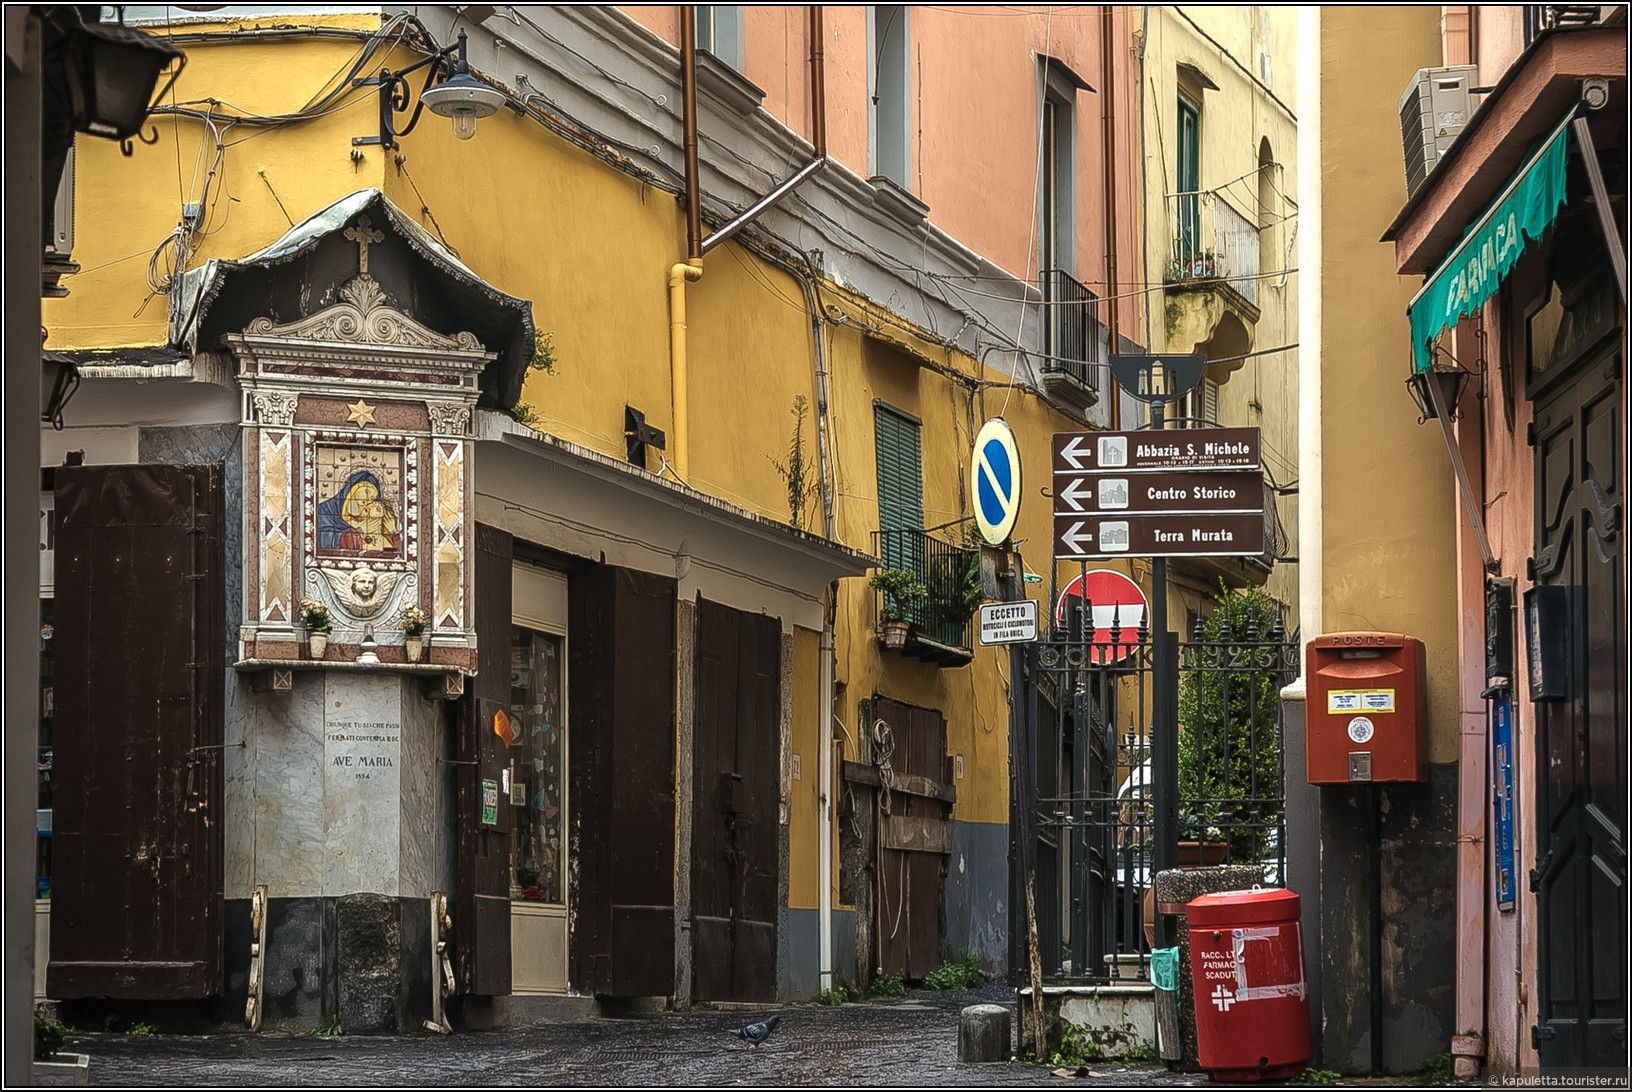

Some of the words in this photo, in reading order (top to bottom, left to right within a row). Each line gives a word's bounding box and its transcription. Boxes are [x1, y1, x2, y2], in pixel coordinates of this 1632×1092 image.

[1136, 444, 1180, 458] Abbazia
[1187, 443, 1199, 456] S.
[1205, 441, 1250, 456] Michele
[1147, 487, 1187, 500] Centro
[1193, 485, 1236, 499] Storico
[1154, 529, 1184, 542] Terra
[1192, 528, 1233, 542] Murata
[991, 607, 1025, 620] ECCETTO
[999, 630, 1009, 639] FILA
[1332, 635, 1386, 646] POSTE
[332, 756, 353, 767] AVE
[358, 756, 393, 767] MARIA
